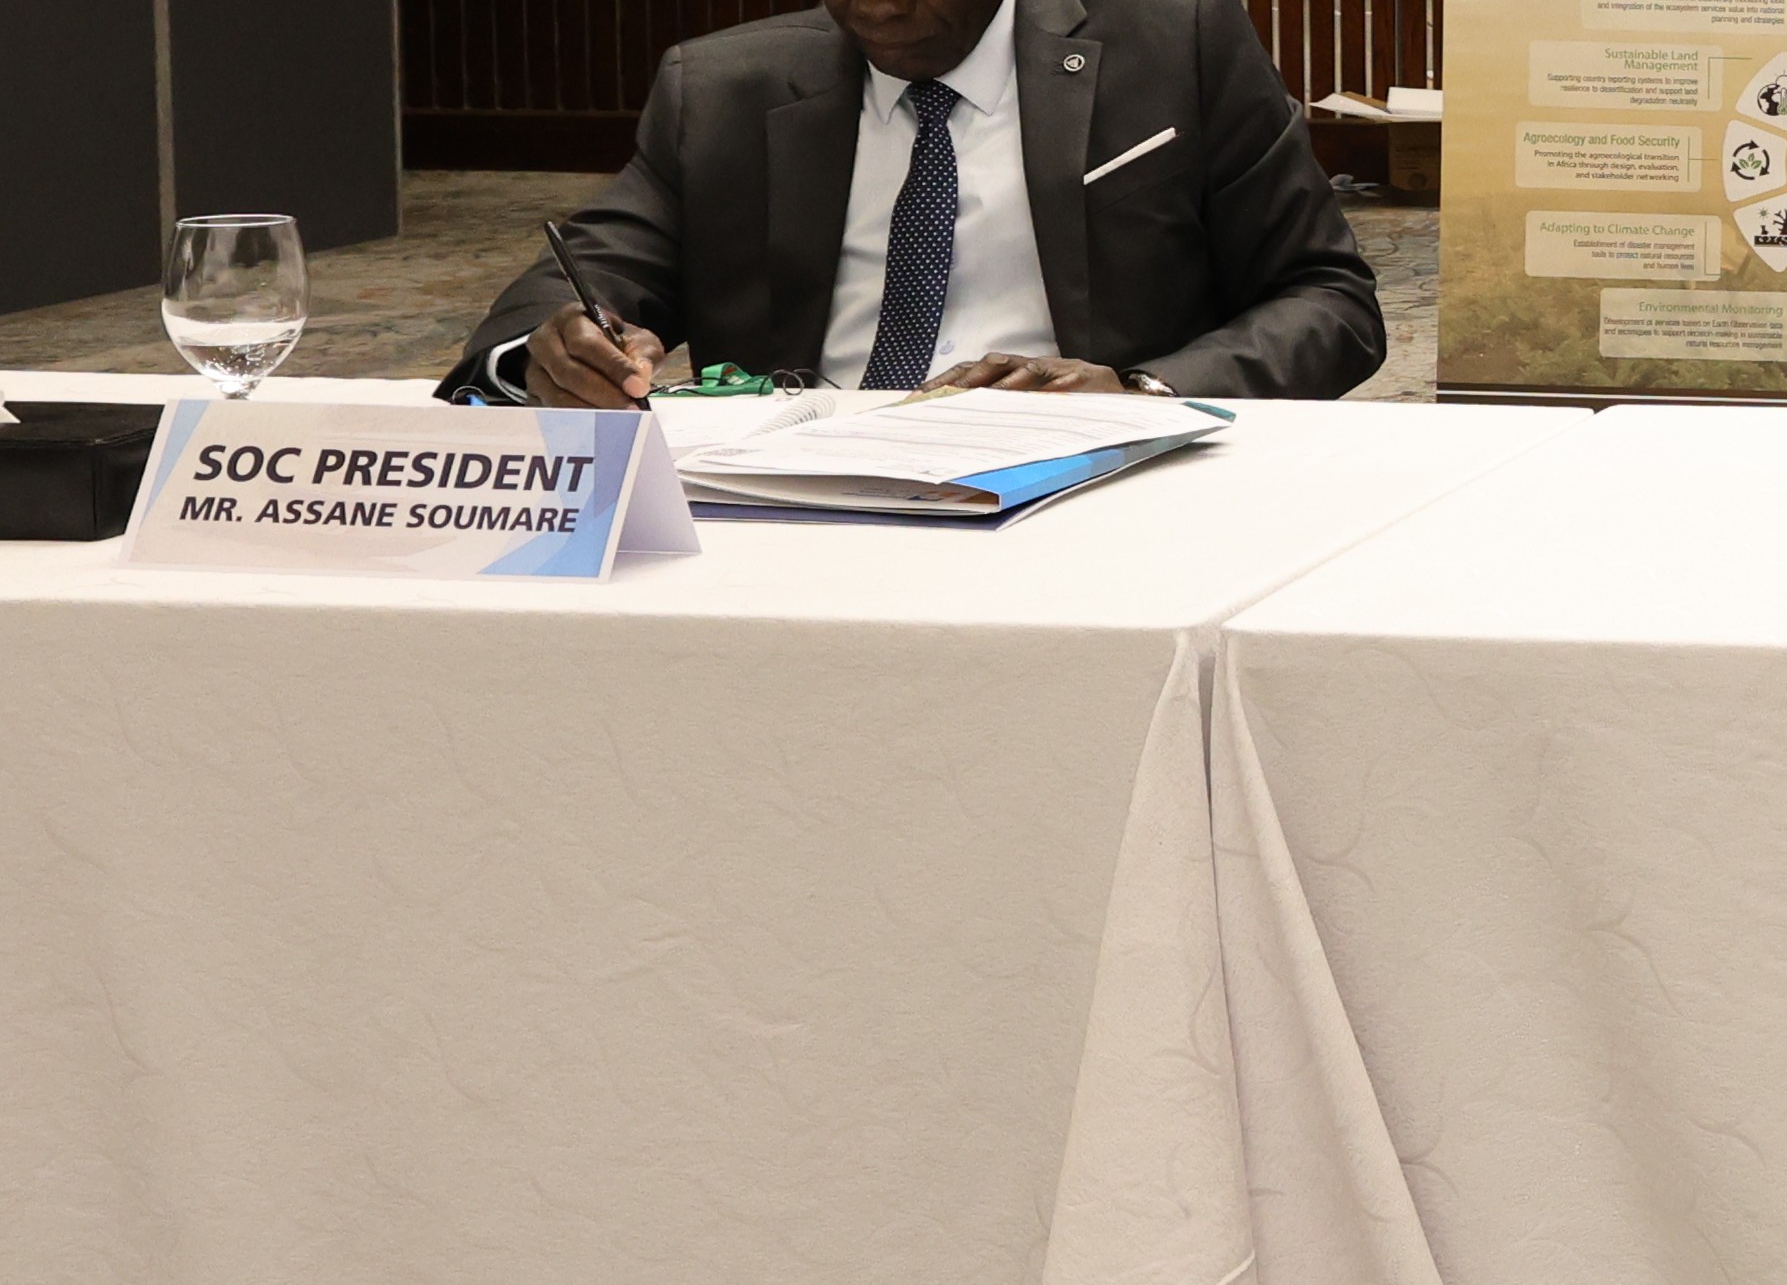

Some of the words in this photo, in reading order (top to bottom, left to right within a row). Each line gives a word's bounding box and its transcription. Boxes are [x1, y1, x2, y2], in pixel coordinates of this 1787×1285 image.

[193, 444, 301, 483] SOC
[312, 449, 594, 490] PRESIDENT
[179, 496, 242, 521] MR.
[254, 499, 397, 526] ASSANE
[405, 504, 579, 532] SOUMARE
